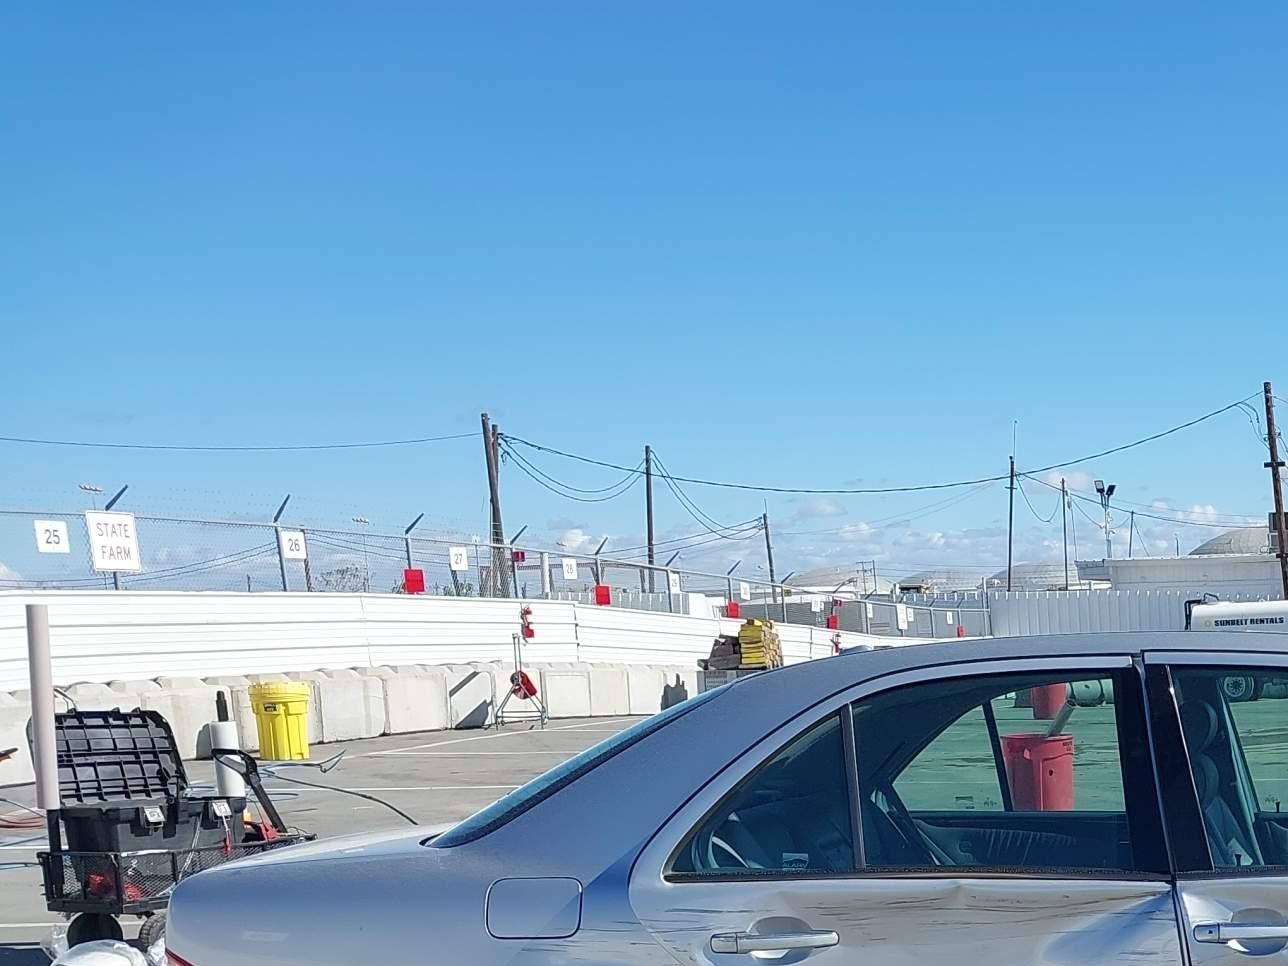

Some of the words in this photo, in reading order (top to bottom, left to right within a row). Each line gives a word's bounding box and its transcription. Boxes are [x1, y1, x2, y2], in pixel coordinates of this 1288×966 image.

[44, 529, 61, 545] 25
[96, 523, 130, 538] STATE
[288, 538, 301, 552] 26
[101, 545, 131, 561] FARM
[454, 552, 463, 565] 27
[1214, 618, 1248, 627] SUNBELT
[1249, 616, 1285, 625] RENTALS
